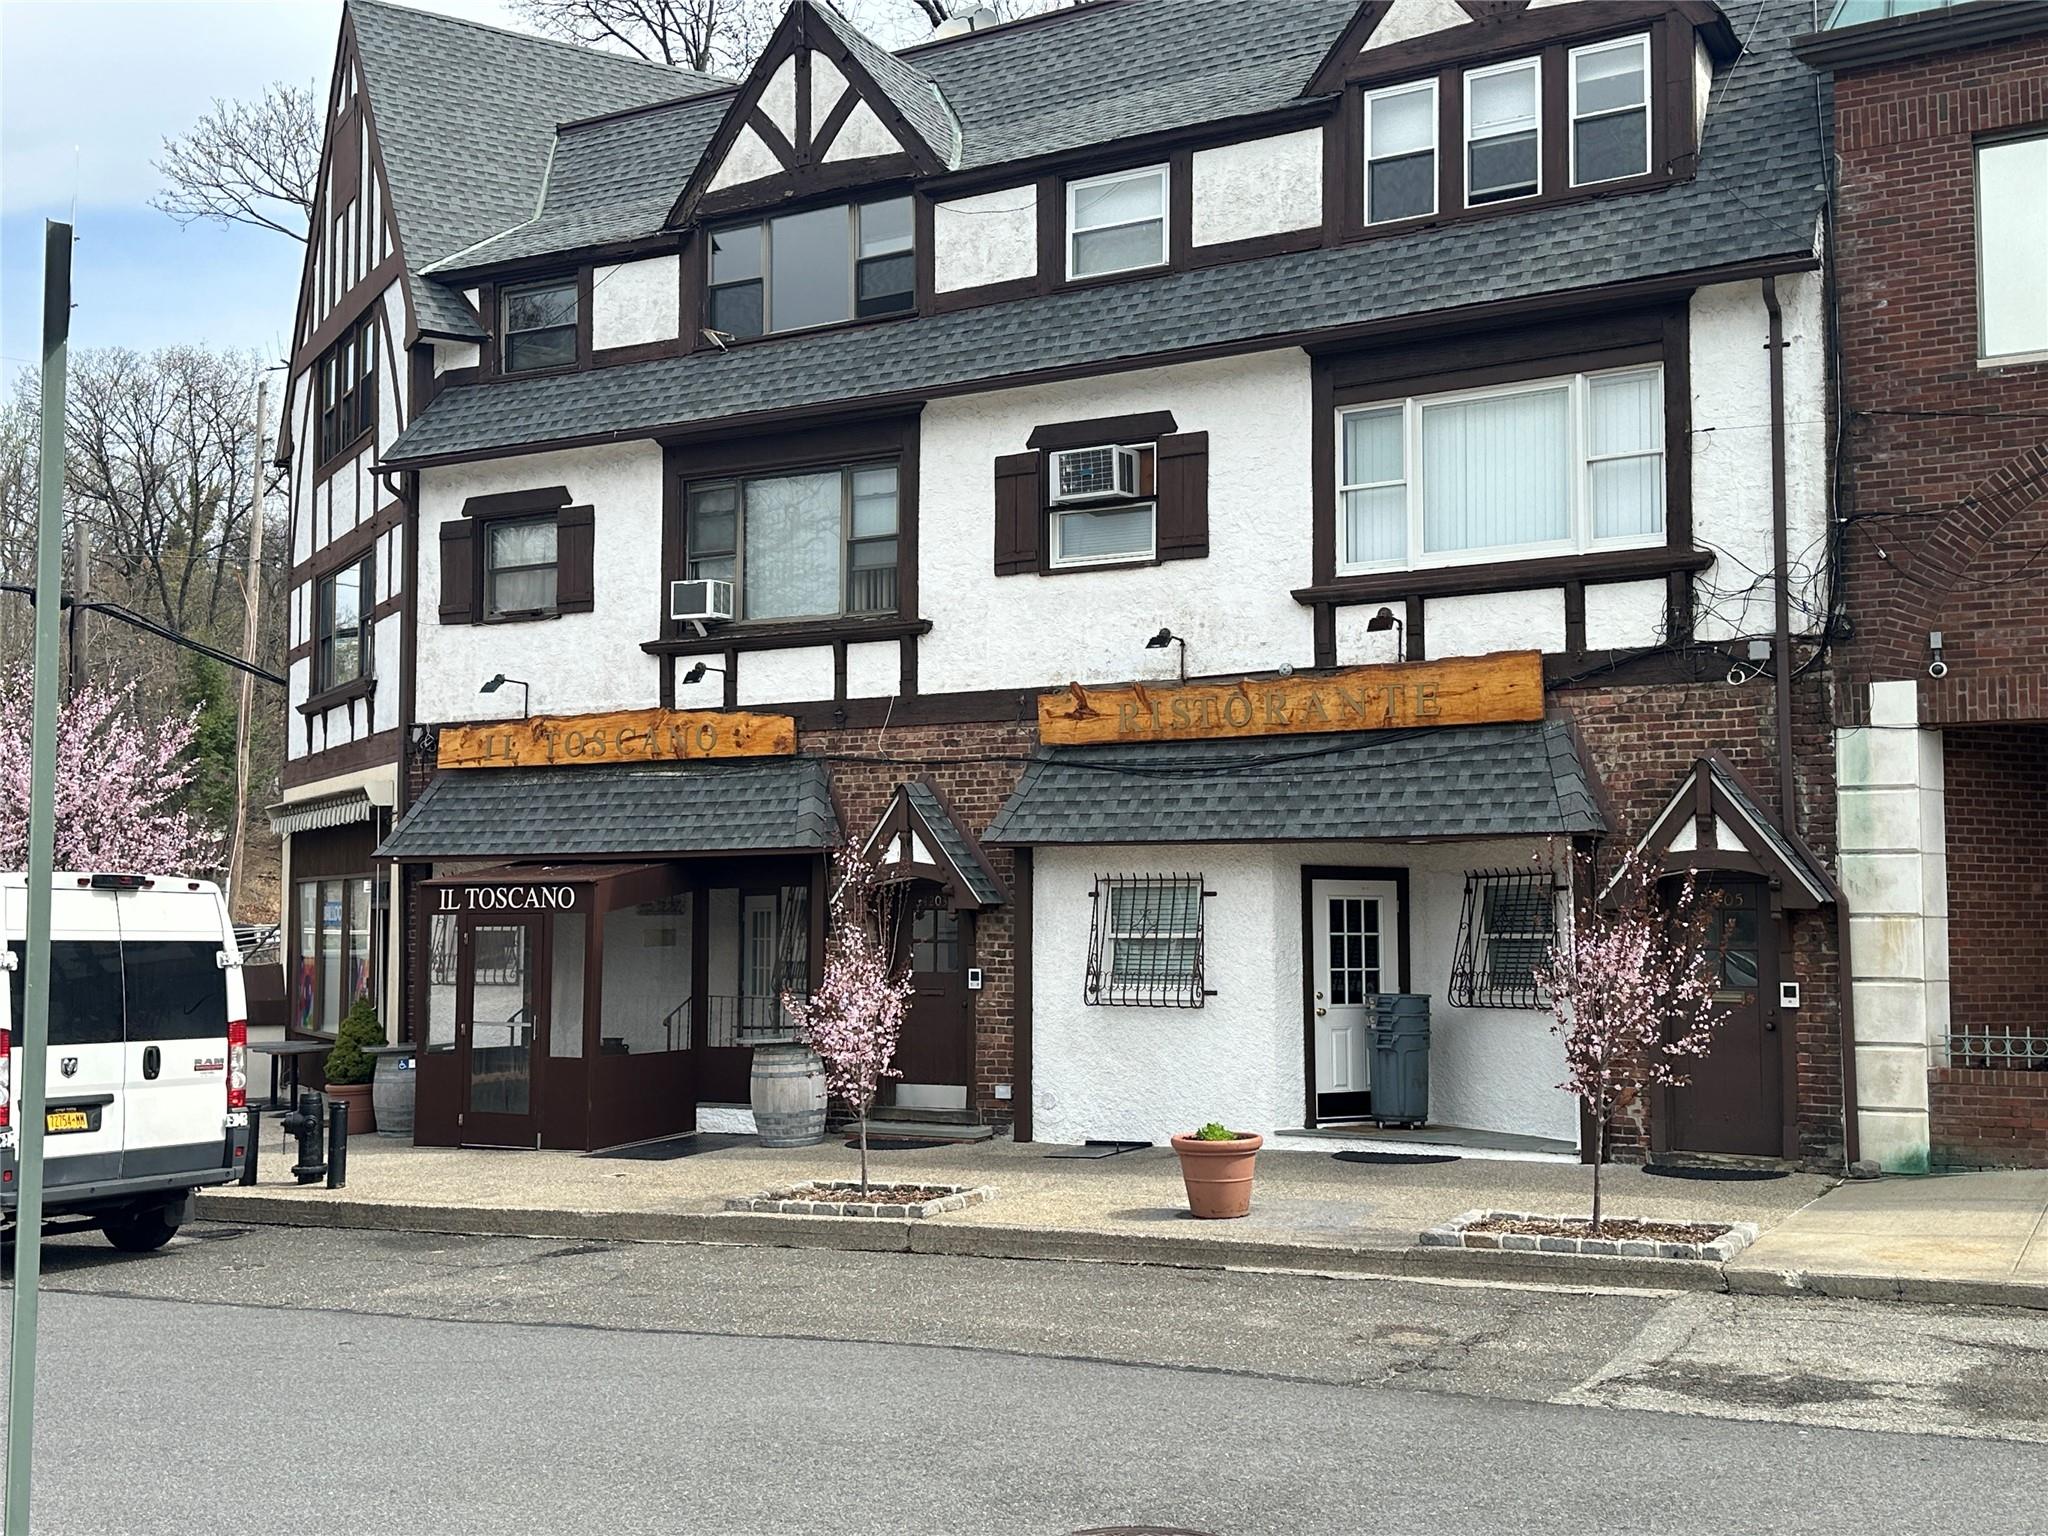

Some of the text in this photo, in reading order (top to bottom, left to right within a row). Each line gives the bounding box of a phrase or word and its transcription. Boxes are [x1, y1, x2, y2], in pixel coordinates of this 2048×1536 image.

[1117, 681, 1442, 733] RISTORANTE
[485, 724, 719, 762] IL TOSCANO
[439, 886, 576, 911] IL TOSCANO
